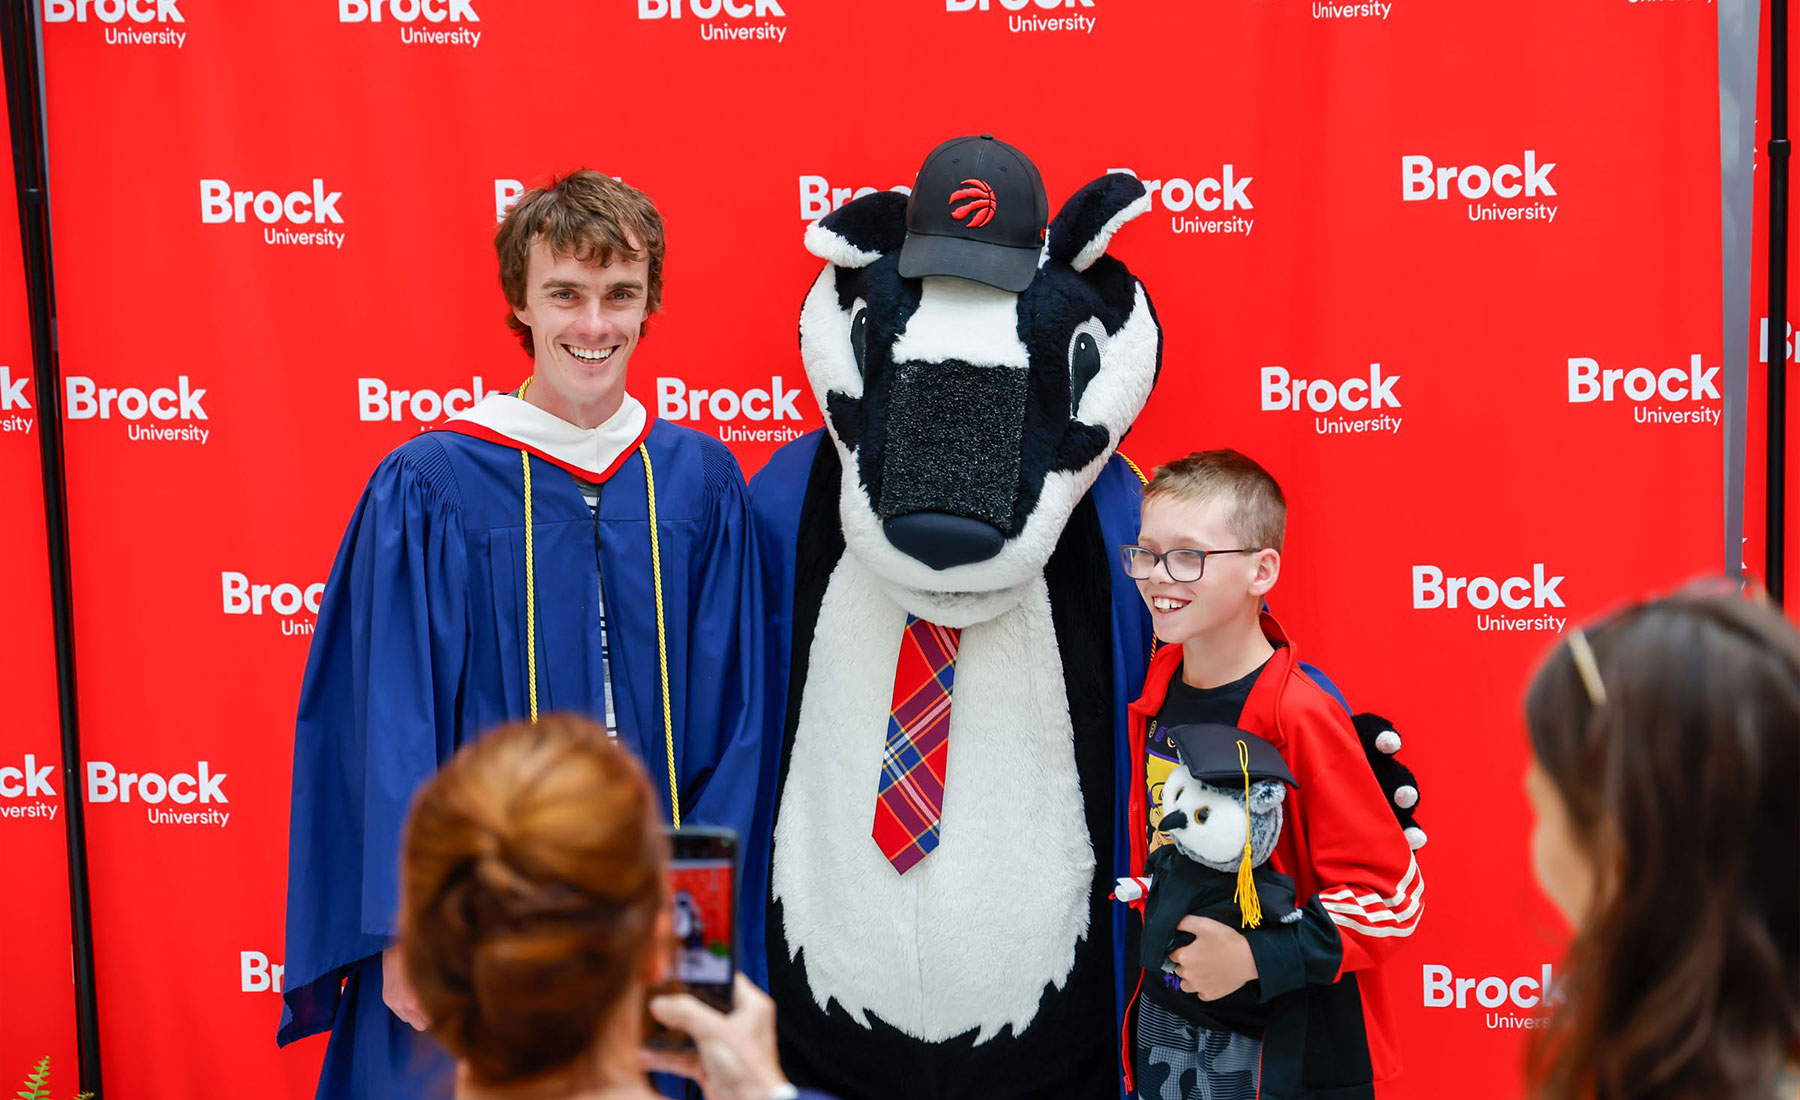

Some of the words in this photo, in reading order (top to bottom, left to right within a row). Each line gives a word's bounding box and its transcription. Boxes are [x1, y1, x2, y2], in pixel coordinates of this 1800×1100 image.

[1312, 1, 1392, 20] University
[701, 23, 787, 43] University
[1009, 13, 1096, 34] University
[105, 27, 187, 49] University
[401, 27, 481, 48] University
[1402, 150, 1557, 202] Brock
[1107, 164, 1254, 212] rock
[200, 179, 344, 224] Brock
[1468, 203, 1558, 224] University
[1172, 216, 1254, 236] University
[264, 227, 345, 249] University
[1261, 363, 1402, 411] Brock
[1568, 353, 1721, 402] Brock
[66, 376, 208, 421] Brock
[657, 376, 803, 422] Brock
[1315, 414, 1403, 434] University
[1635, 406, 1721, 427] University
[128, 424, 210, 445] University
[720, 425, 804, 443] University
[222, 571, 326, 616] Broc
[1412, 564, 1566, 610] Brock
[1477, 614, 1567, 635] University
[87, 761, 229, 804] Brock
[0, 801, 58, 821] versity
[148, 806, 230, 828] University
